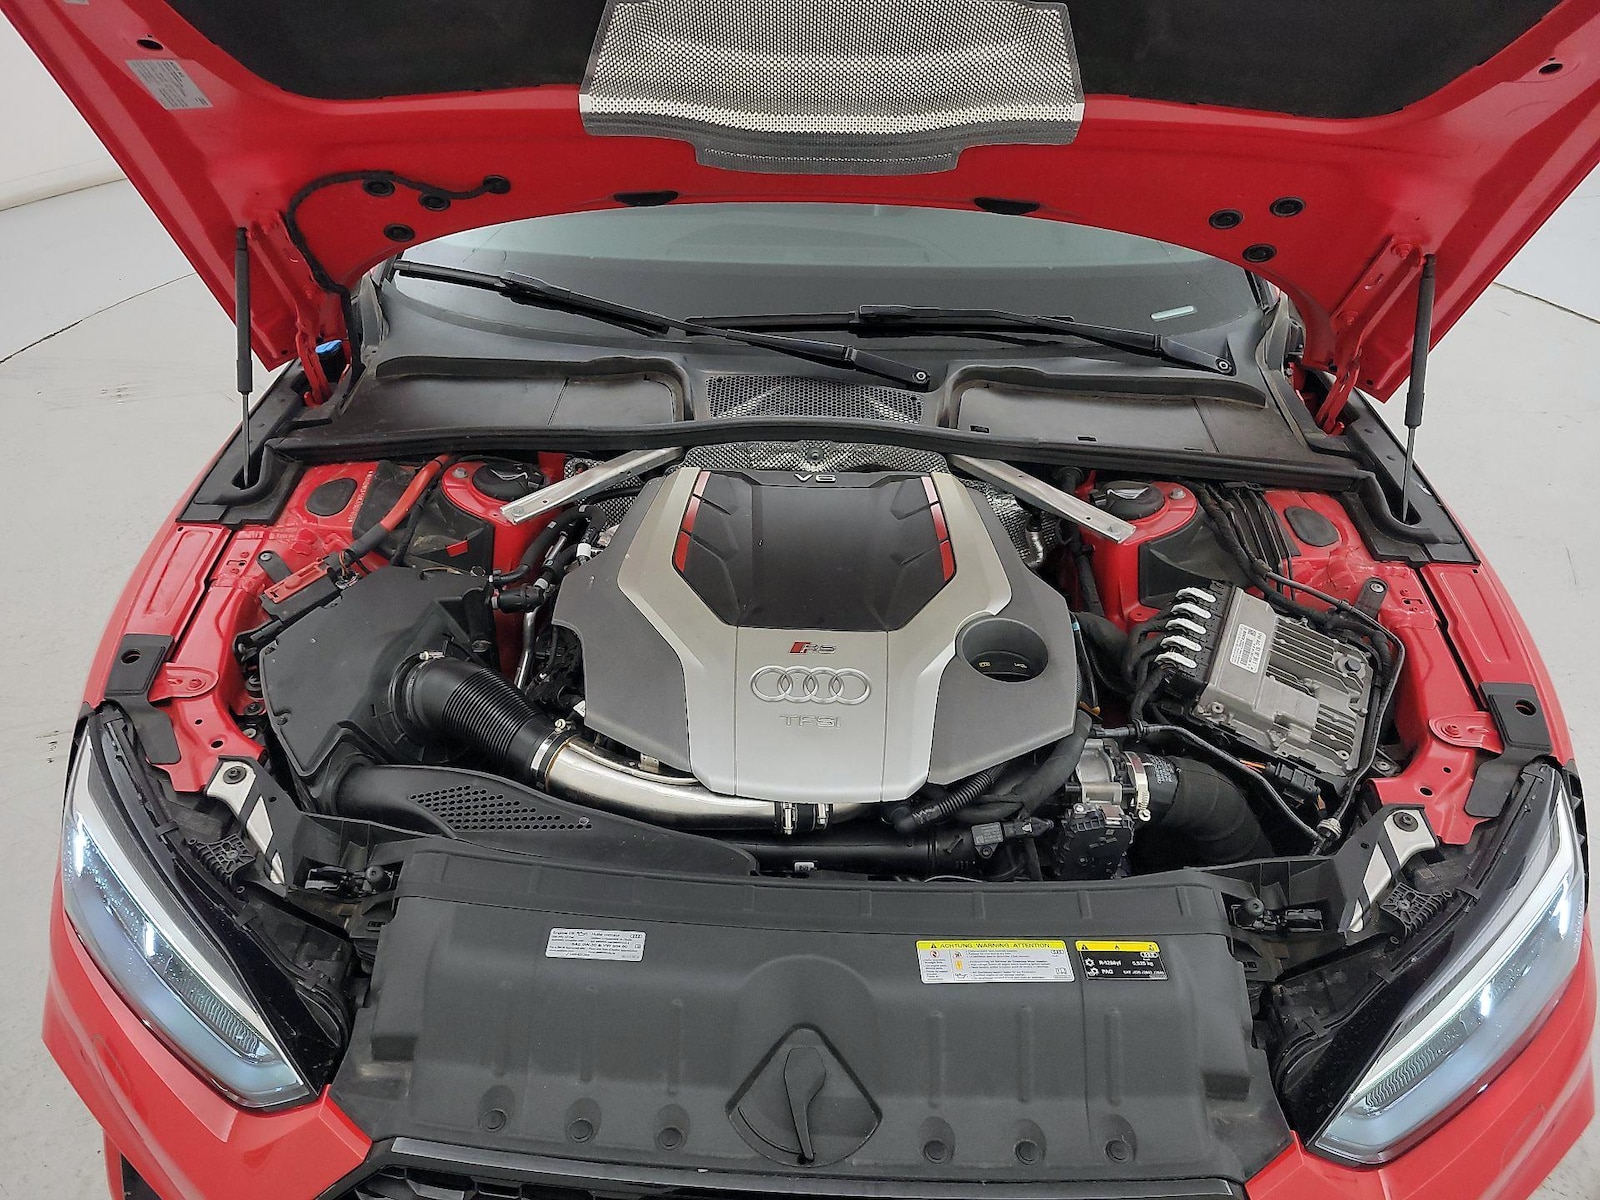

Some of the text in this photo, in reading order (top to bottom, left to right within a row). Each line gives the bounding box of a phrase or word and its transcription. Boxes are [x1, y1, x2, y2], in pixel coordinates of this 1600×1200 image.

[793, 472, 837, 483] V6
[792, 641, 837, 655] RS
[780, 714, 841, 728] TFSI
